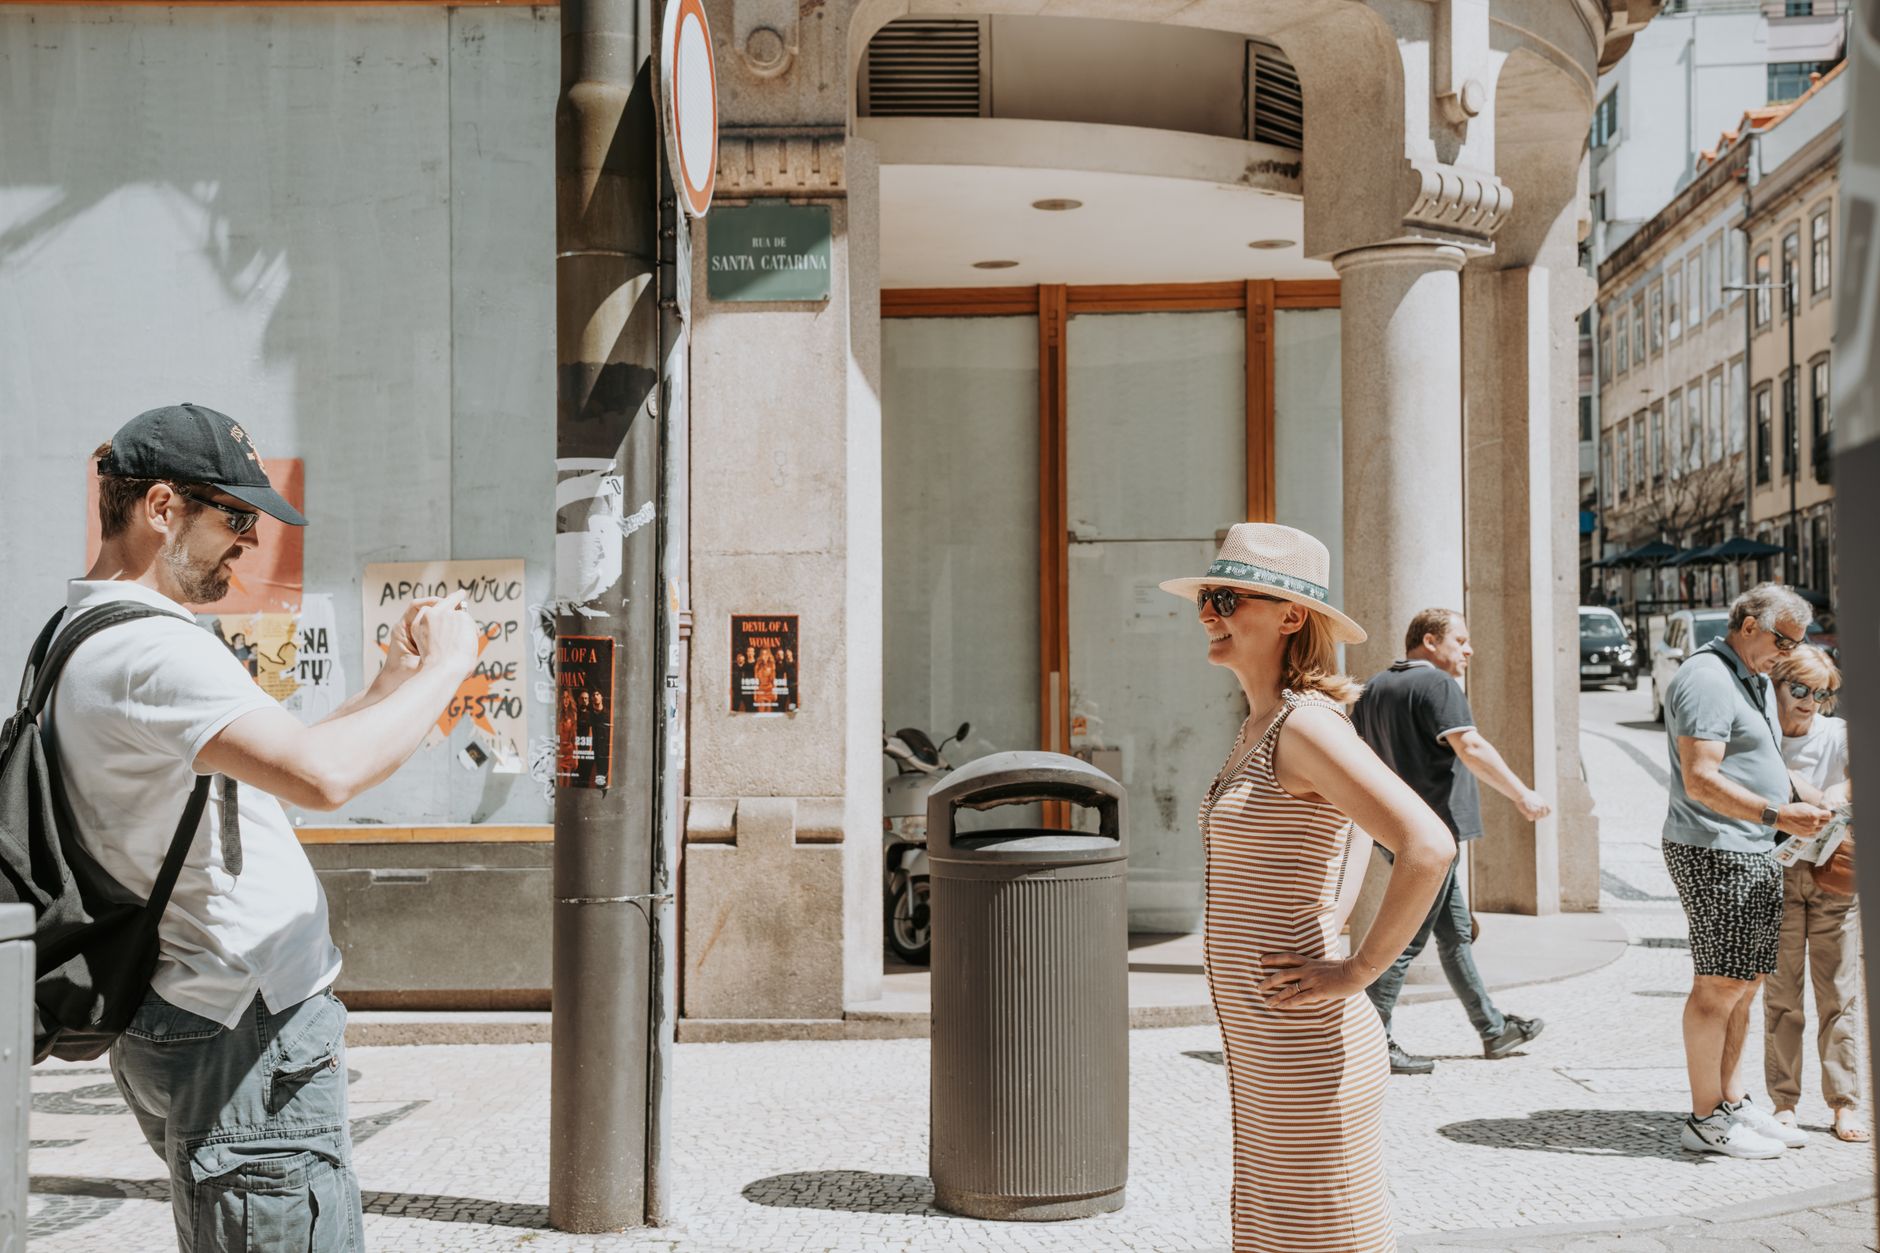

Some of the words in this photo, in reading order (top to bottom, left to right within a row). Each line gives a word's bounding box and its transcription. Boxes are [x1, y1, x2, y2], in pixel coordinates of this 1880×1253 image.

[752, 237, 771, 248] RUA
[774, 237, 787, 248] DE
[711, 255, 755, 271] SANTA
[760, 254, 828, 271] CATARINA
[379, 580, 448, 607] APOIO
[742, 621, 768, 632] DEVIL
[769, 621, 781, 632] OF
[782, 621, 789, 632] A
[749, 637, 781, 648] WOMAN
[571, 647, 587, 663] OF
[588, 647, 598, 663] A
